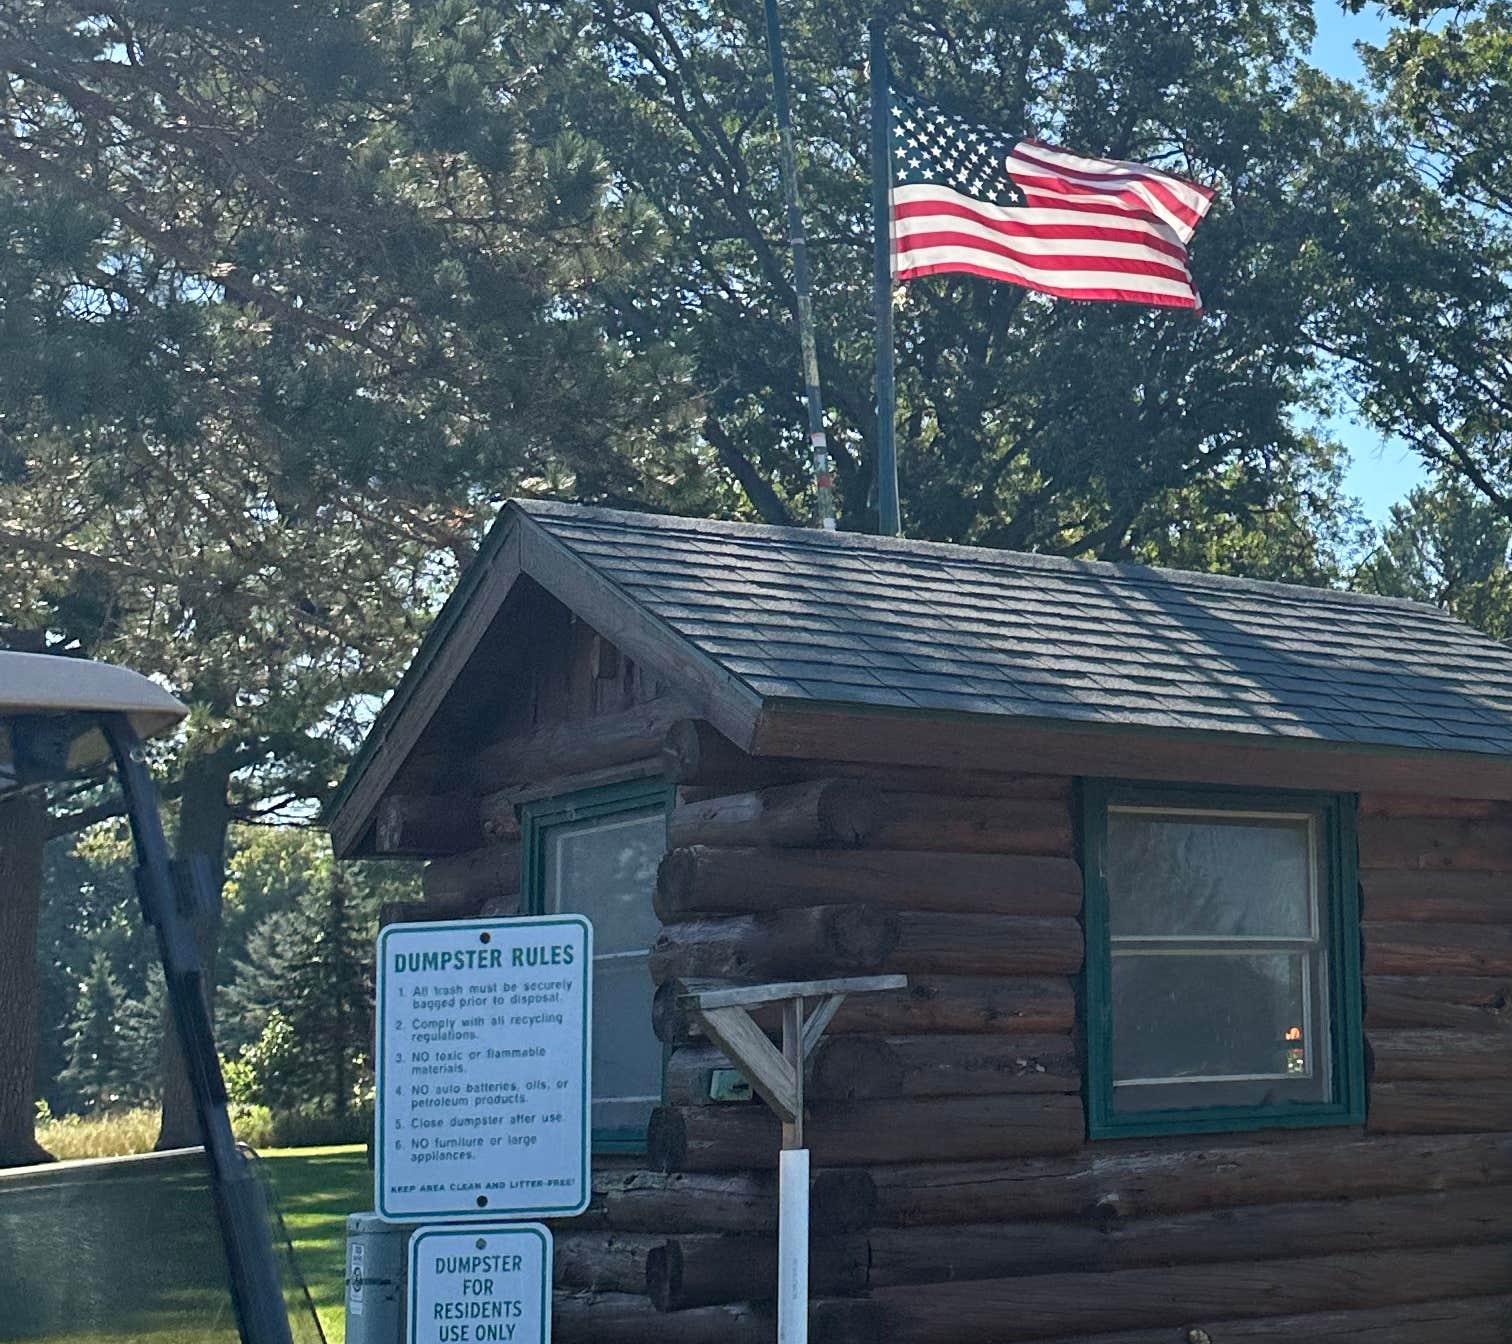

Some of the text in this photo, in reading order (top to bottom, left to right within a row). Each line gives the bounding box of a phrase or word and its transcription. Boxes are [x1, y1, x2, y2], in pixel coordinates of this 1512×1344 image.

[395, 945, 575, 974] DUMPSTER RULES
[413, 986, 427, 996] All
[434, 984, 463, 995] trash
[469, 984, 497, 993] must
[504, 983, 517, 992] be
[524, 980, 572, 991] securely
[413, 999, 455, 1010] bagged
[460, 997, 487, 1008] prior
[493, 997, 504, 1005] to
[412, 1018, 455, 1033] Comply
[462, 1017, 484, 1027] with
[491, 1017, 504, 1026] all
[511, 1013, 563, 1025] recycling
[412, 1052, 430, 1062] NO
[436, 1051, 462, 1061] toxic
[469, 1051, 480, 1059] or
[487, 1047, 546, 1058] flammable
[412, 1085, 429, 1095] NO
[436, 1085, 460, 1095] auto
[557, 1080, 568, 1088] or
[411, 1097, 468, 1111] petroleum
[411, 1118, 444, 1129] Close
[450, 1116, 503, 1129] dumpster
[510, 1113, 536, 1124] after
[412, 1139, 429, 1149] NO
[435, 1138, 483, 1148] furniture
[490, 1137, 502, 1146] or
[508, 1135, 537, 1146] large
[411, 1151, 475, 1163] appliances.
[391, 1186, 415, 1194] KEEP
[436, 1256, 522, 1273] DUMPSTER
[463, 1279, 493, 1295] FOR
[434, 1301, 522, 1319] RESIDENTS
[439, 1324, 515, 1341] USE ONLY
